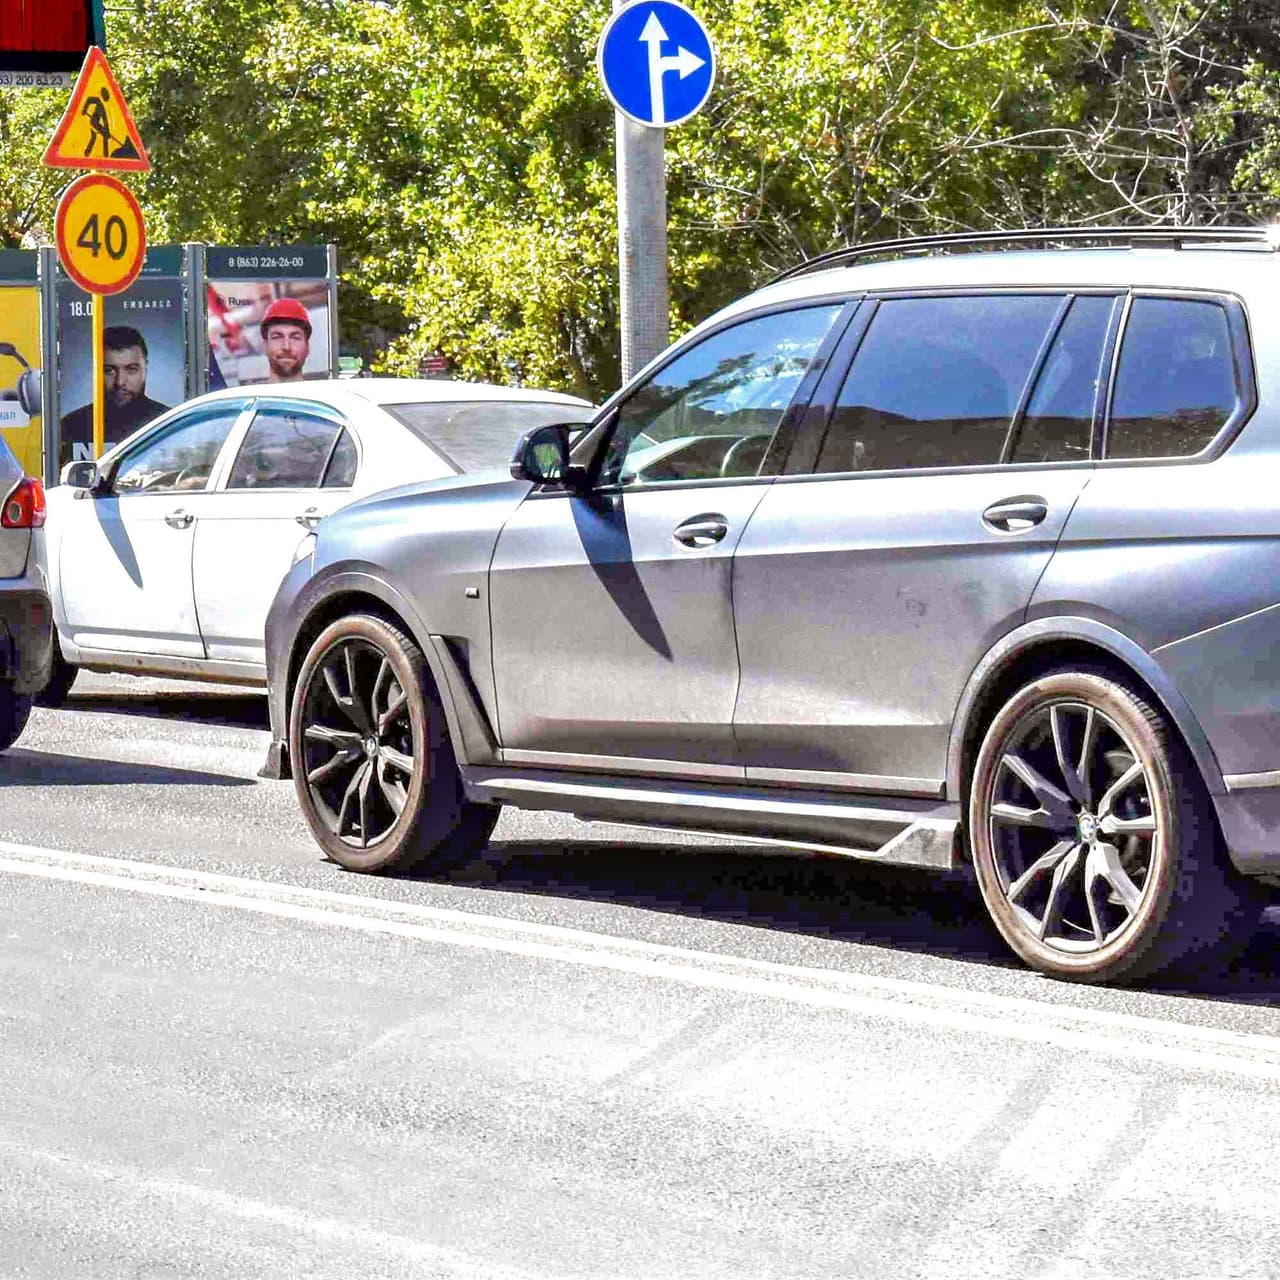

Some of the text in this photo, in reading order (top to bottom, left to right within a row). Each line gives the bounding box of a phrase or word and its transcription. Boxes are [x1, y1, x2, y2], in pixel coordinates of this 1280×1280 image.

[15, 74, 34, 86] 200
[76, 213, 128, 261] 40
[228, 256, 304, 269] 8 (863) 226-26-00
[69, 301, 93, 317] 18.0
